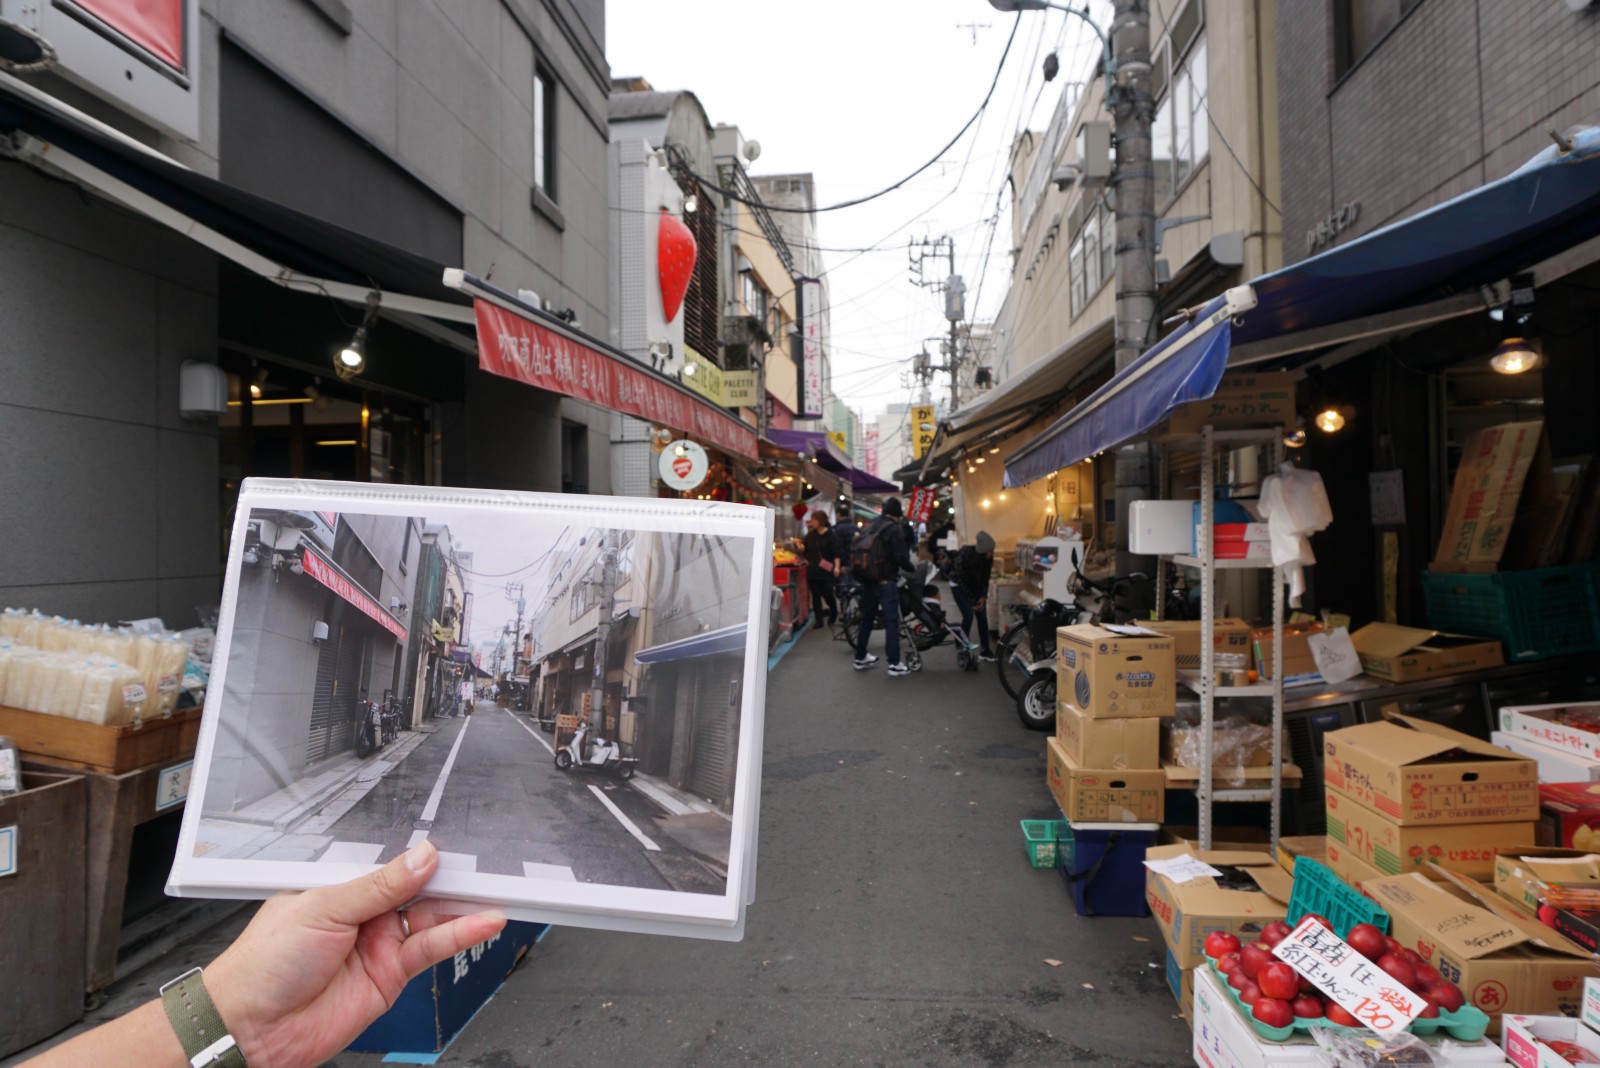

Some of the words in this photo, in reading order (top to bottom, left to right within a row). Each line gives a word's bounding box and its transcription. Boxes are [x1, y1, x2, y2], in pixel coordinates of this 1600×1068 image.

[724, 378, 754, 388] PALETTE
[730, 390, 748, 398] CLUB
[1345, 818, 1374, 861] トマト
[1300, 926, 1347, 964] 青森
[1439, 957, 1461, 984] なす
[1353, 996, 1395, 1029] 130
